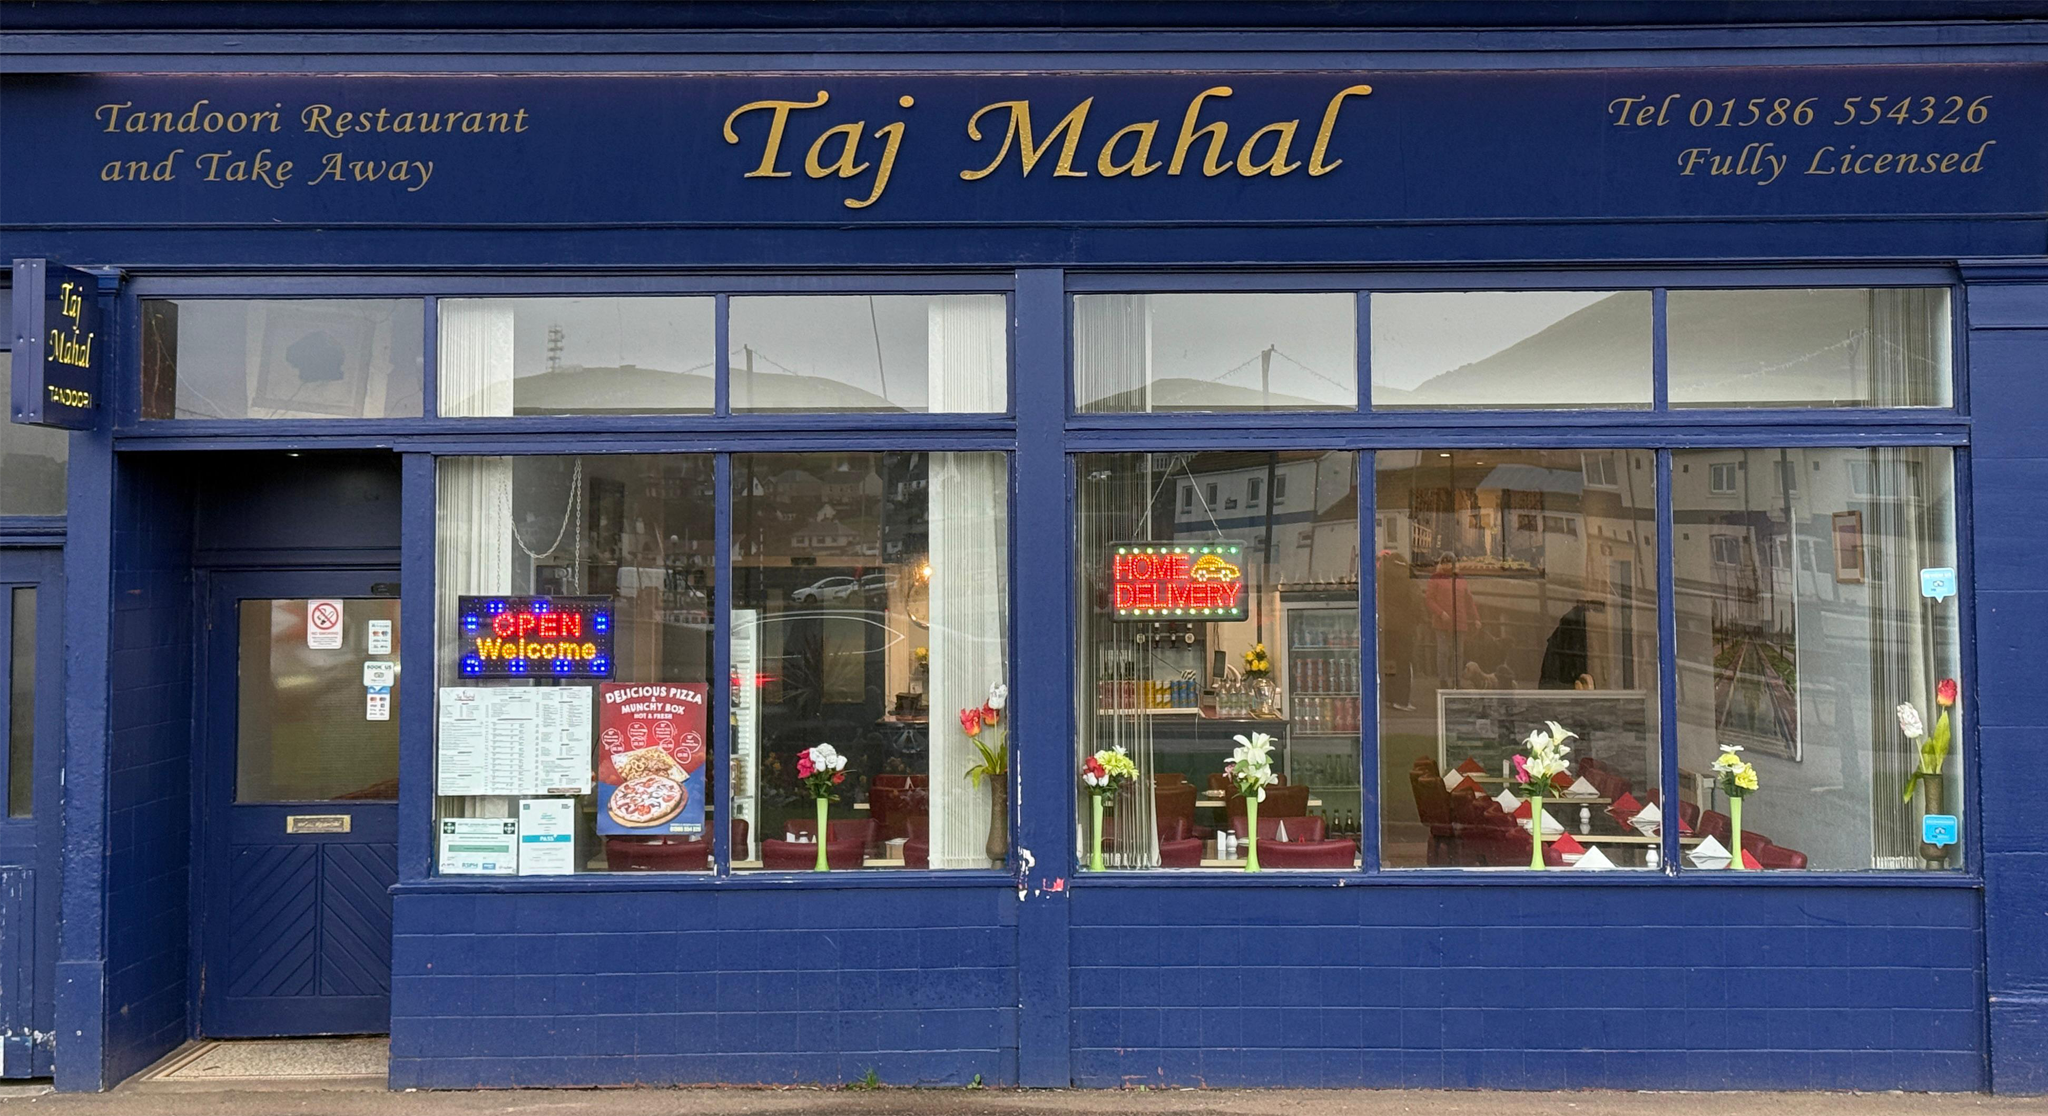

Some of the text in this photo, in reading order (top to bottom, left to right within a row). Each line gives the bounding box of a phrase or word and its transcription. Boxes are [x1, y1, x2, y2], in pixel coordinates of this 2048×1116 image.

[95, 100, 529, 138] Tandoori Restaurant
[1608, 94, 1993, 127] Tel 01586 554326
[723, 85, 1374, 210] Taj Mahal
[101, 149, 434, 192] and Take Away
[1677, 140, 1997, 186] Fully Licensed
[60, 282, 83, 329] Taj
[48, 328, 94, 368] Mahal
[48, 385, 93, 409] TANDOORI
[1115, 554, 1189, 580] HOME
[1115, 582, 1240, 608] DELIVERY
[493, 613, 581, 637] OPEN
[476, 637, 597, 660] Welcome
[605, 686, 702, 704] DELICIOUS PIZZA
[621, 702, 685, 715] MUNCHY BOX
